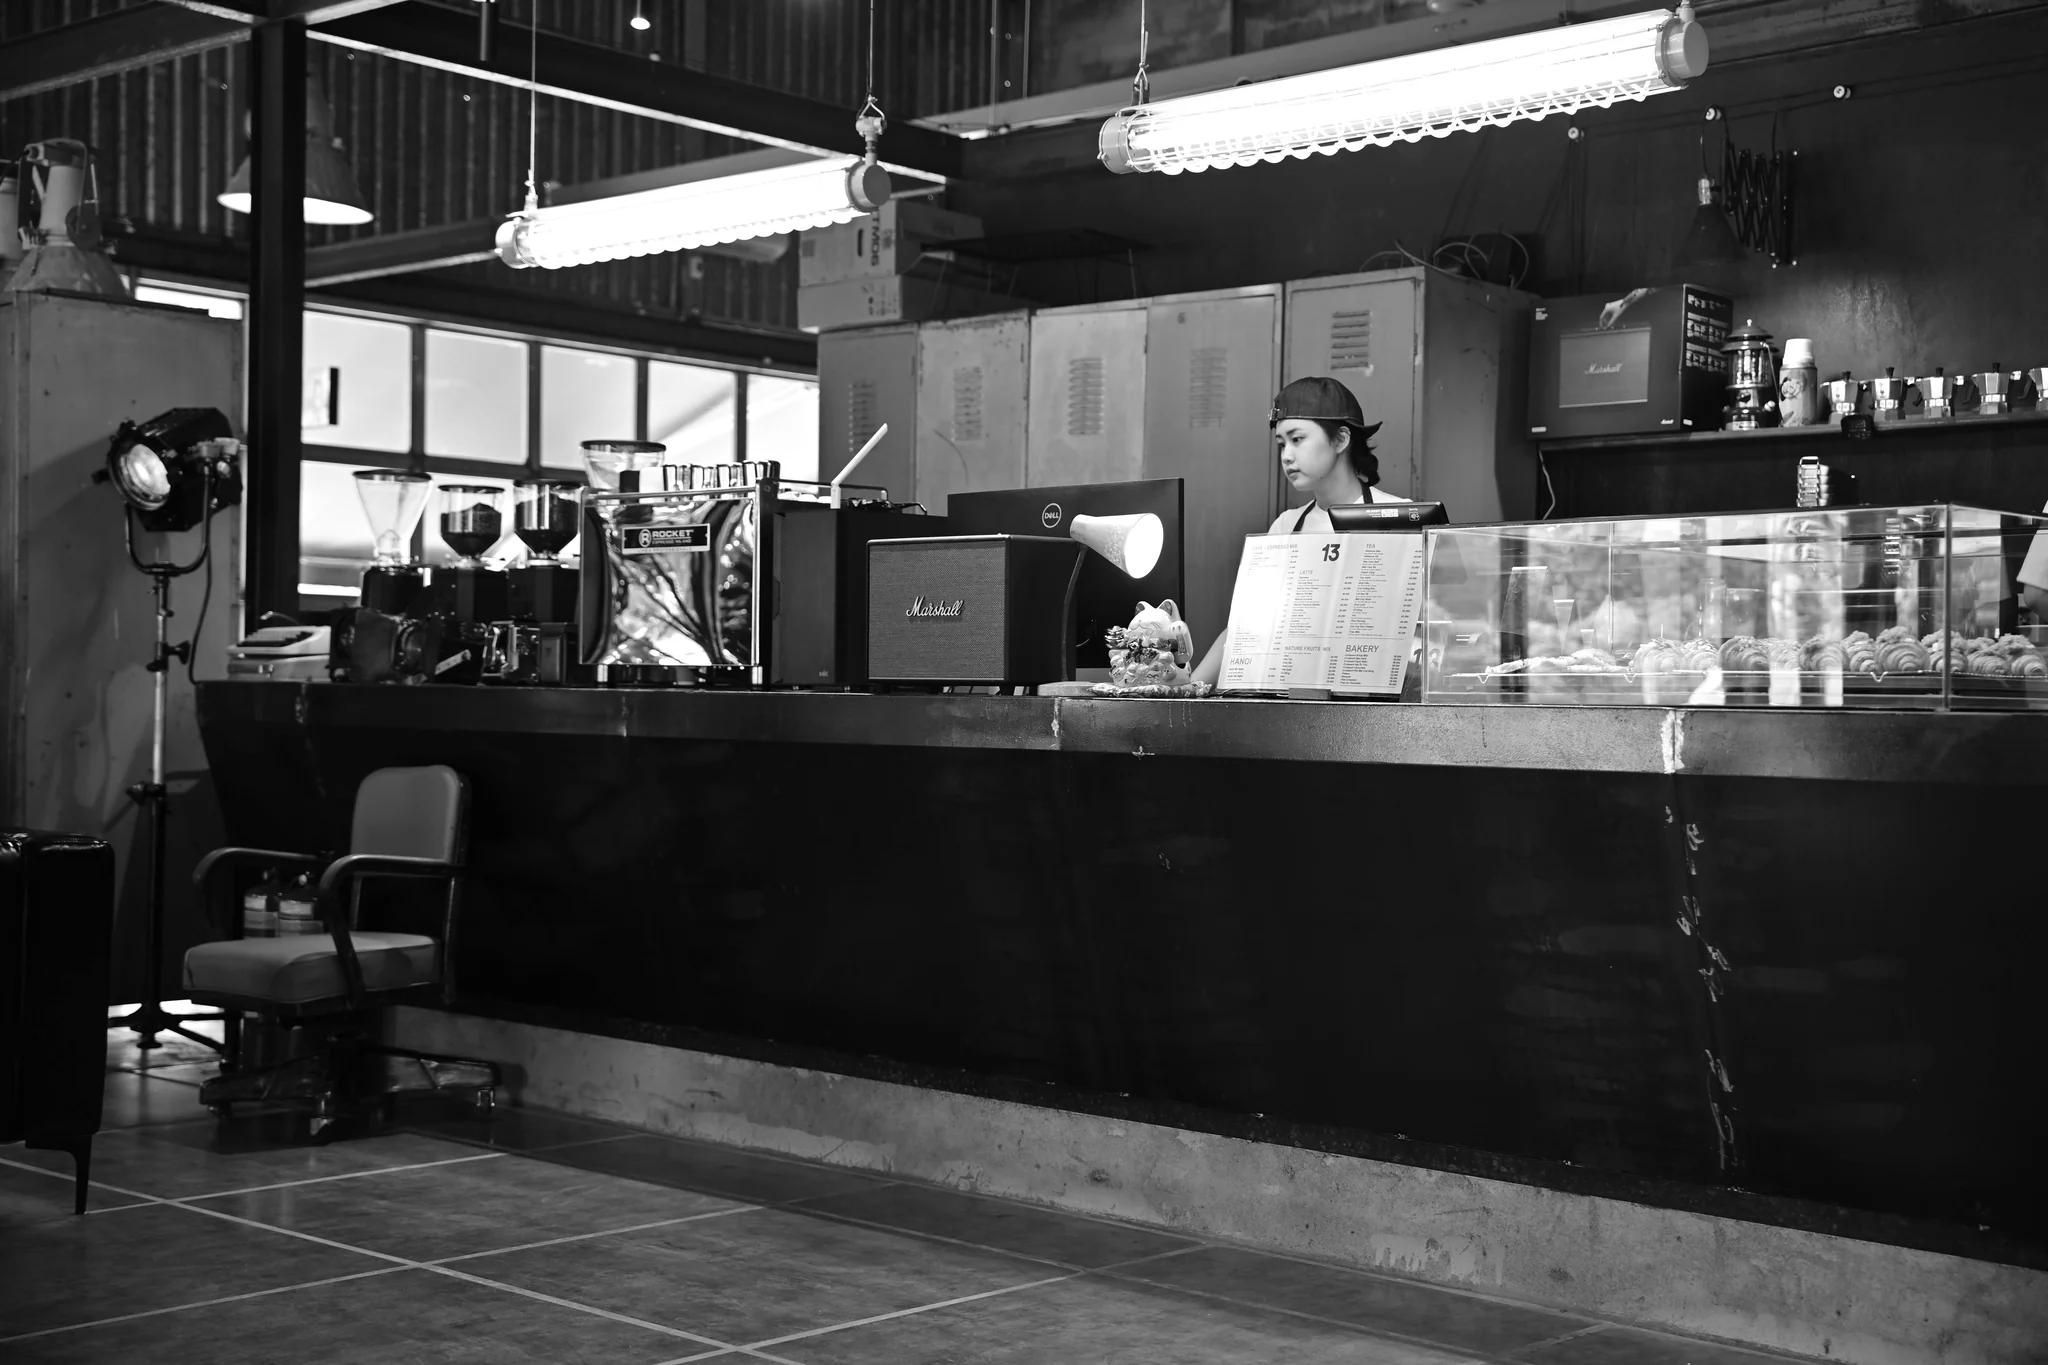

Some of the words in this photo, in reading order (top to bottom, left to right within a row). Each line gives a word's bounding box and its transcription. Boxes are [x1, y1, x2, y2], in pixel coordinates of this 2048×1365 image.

[1584, 362, 1623, 375] Marshall
[652, 530, 692, 538] ROCKET
[1321, 543, 1341, 562] 13
[906, 596, 964, 617] Marshall
[1345, 644, 1380, 653] BAKERY
[1229, 657, 1253, 665] HANOI
